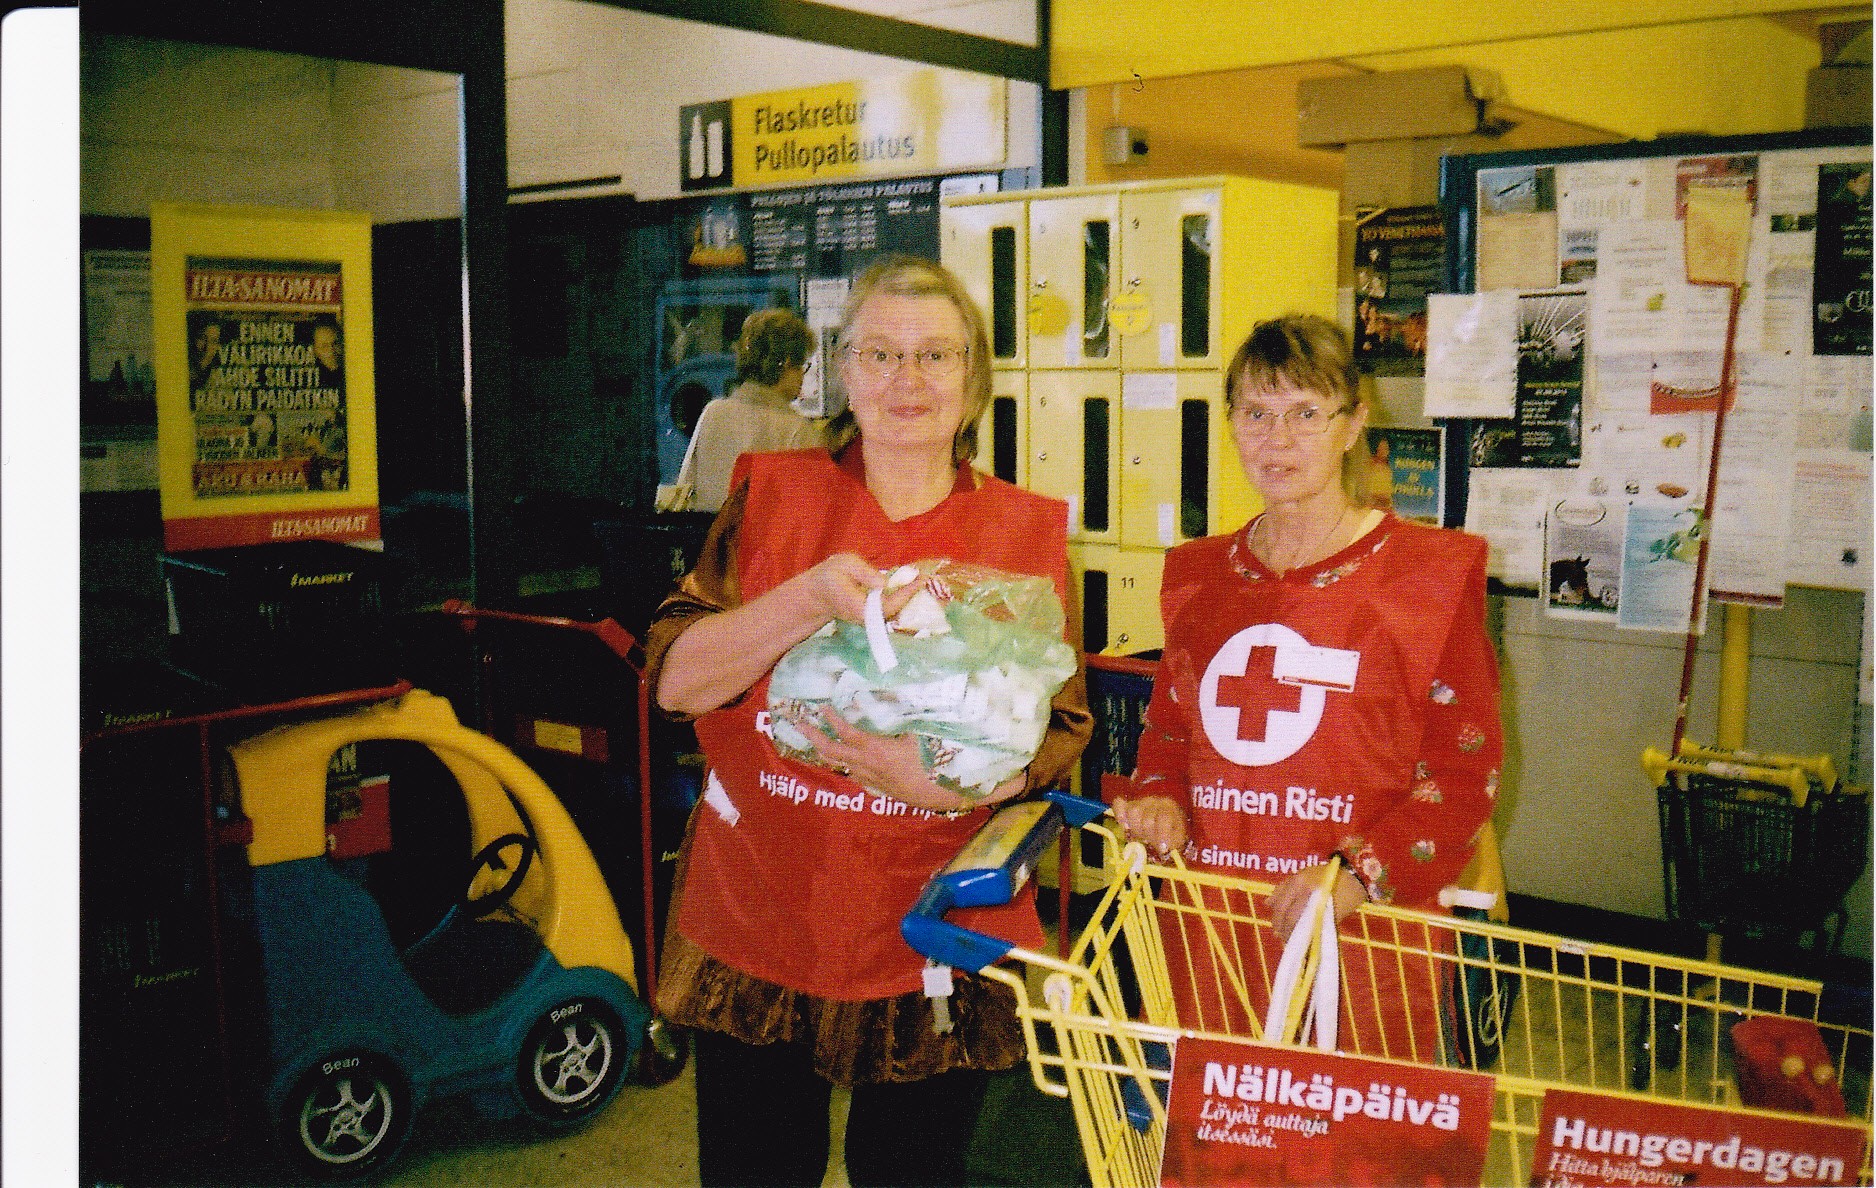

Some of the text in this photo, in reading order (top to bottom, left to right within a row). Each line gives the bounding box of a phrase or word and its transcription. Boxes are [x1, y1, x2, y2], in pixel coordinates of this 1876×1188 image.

[754, 99, 867, 135] Flaskretur
[755, 134, 915, 174] Pullopalautus
[190, 275, 336, 301] ILTA-SANOMAT
[239, 322, 295, 342] ENNEN
[265, 366, 321, 388] SILITTI
[257, 388, 340, 410] PAIDATKIN
[1121, 577, 1135, 589] 11
[759, 770, 808, 806] Hjälp
[814, 788, 865, 812] med
[871, 793, 907, 816] din
[1192, 779, 1355, 824] nainen Risti
[1201, 844, 1261, 871] sinun
[549, 1002, 584, 1023] Bean
[321, 1056, 361, 1076] Bean
[1202, 1061, 1461, 1132] Nälkäpäivä
[1199, 1098, 1330, 1139] Löydä auttaja
[1552, 1116, 1845, 1183] Hungerdagen
[1549, 1151, 1599, 1176] Hitta
[1601, 1157, 1686, 1187] hjälparen
